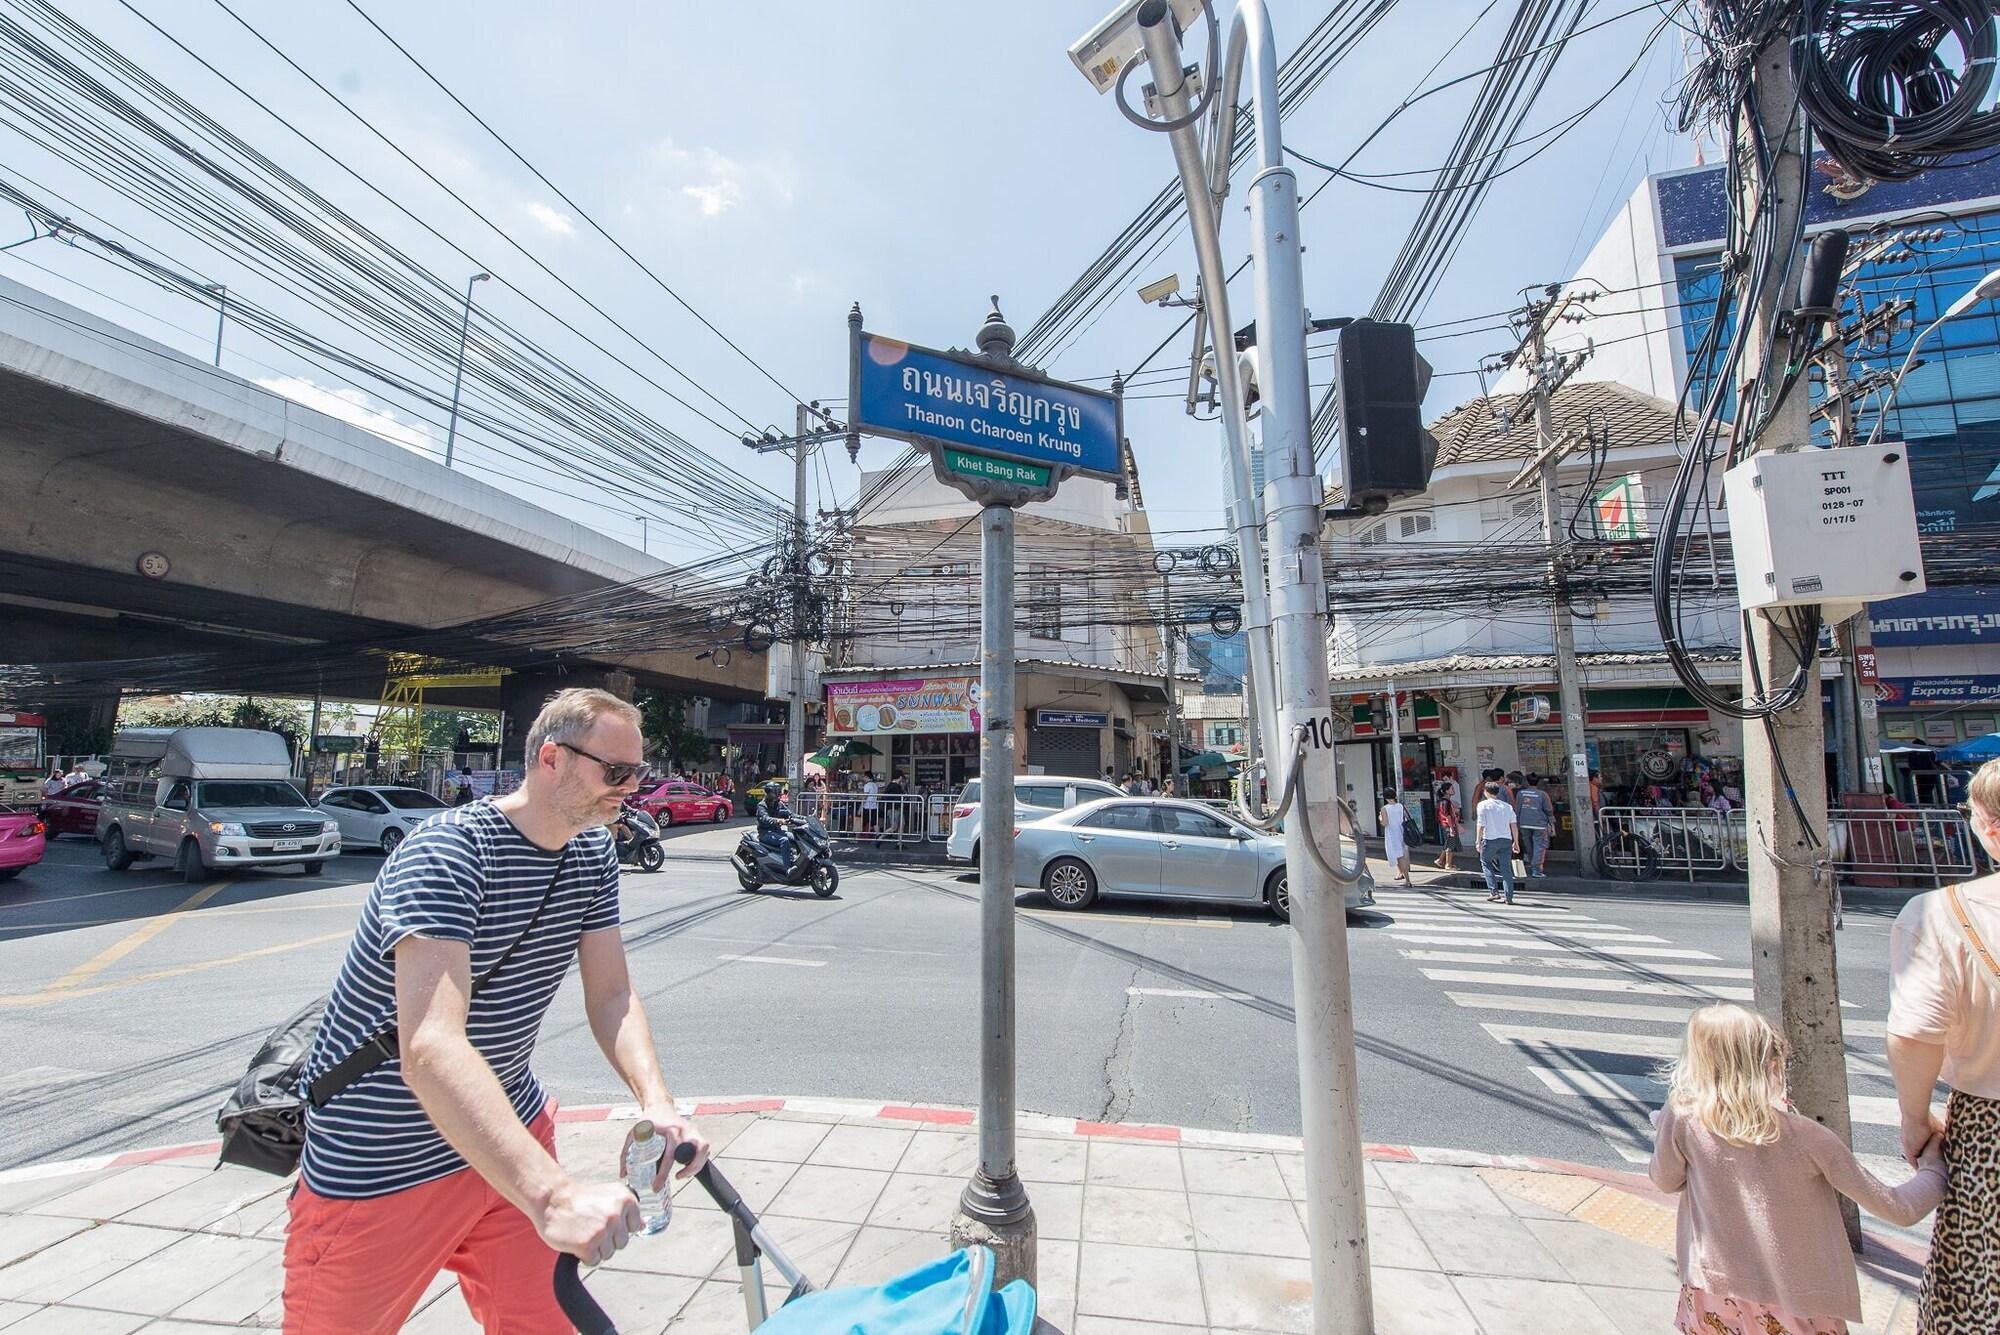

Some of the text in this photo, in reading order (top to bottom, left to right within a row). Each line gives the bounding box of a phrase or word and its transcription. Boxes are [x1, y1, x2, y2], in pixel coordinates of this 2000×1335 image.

[903, 367, 1080, 436] ถนนเจริญกรุง
[905, 403, 1081, 457] Thanon Charoen Krung
[957, 456, 1036, 480] Khet Bang Rak
[1821, 470, 1846, 481] TTT
[1824, 486, 1851, 495] SP001
[1911, 686, 1964, 697] Express
[1306, 717, 1332, 749] 10
